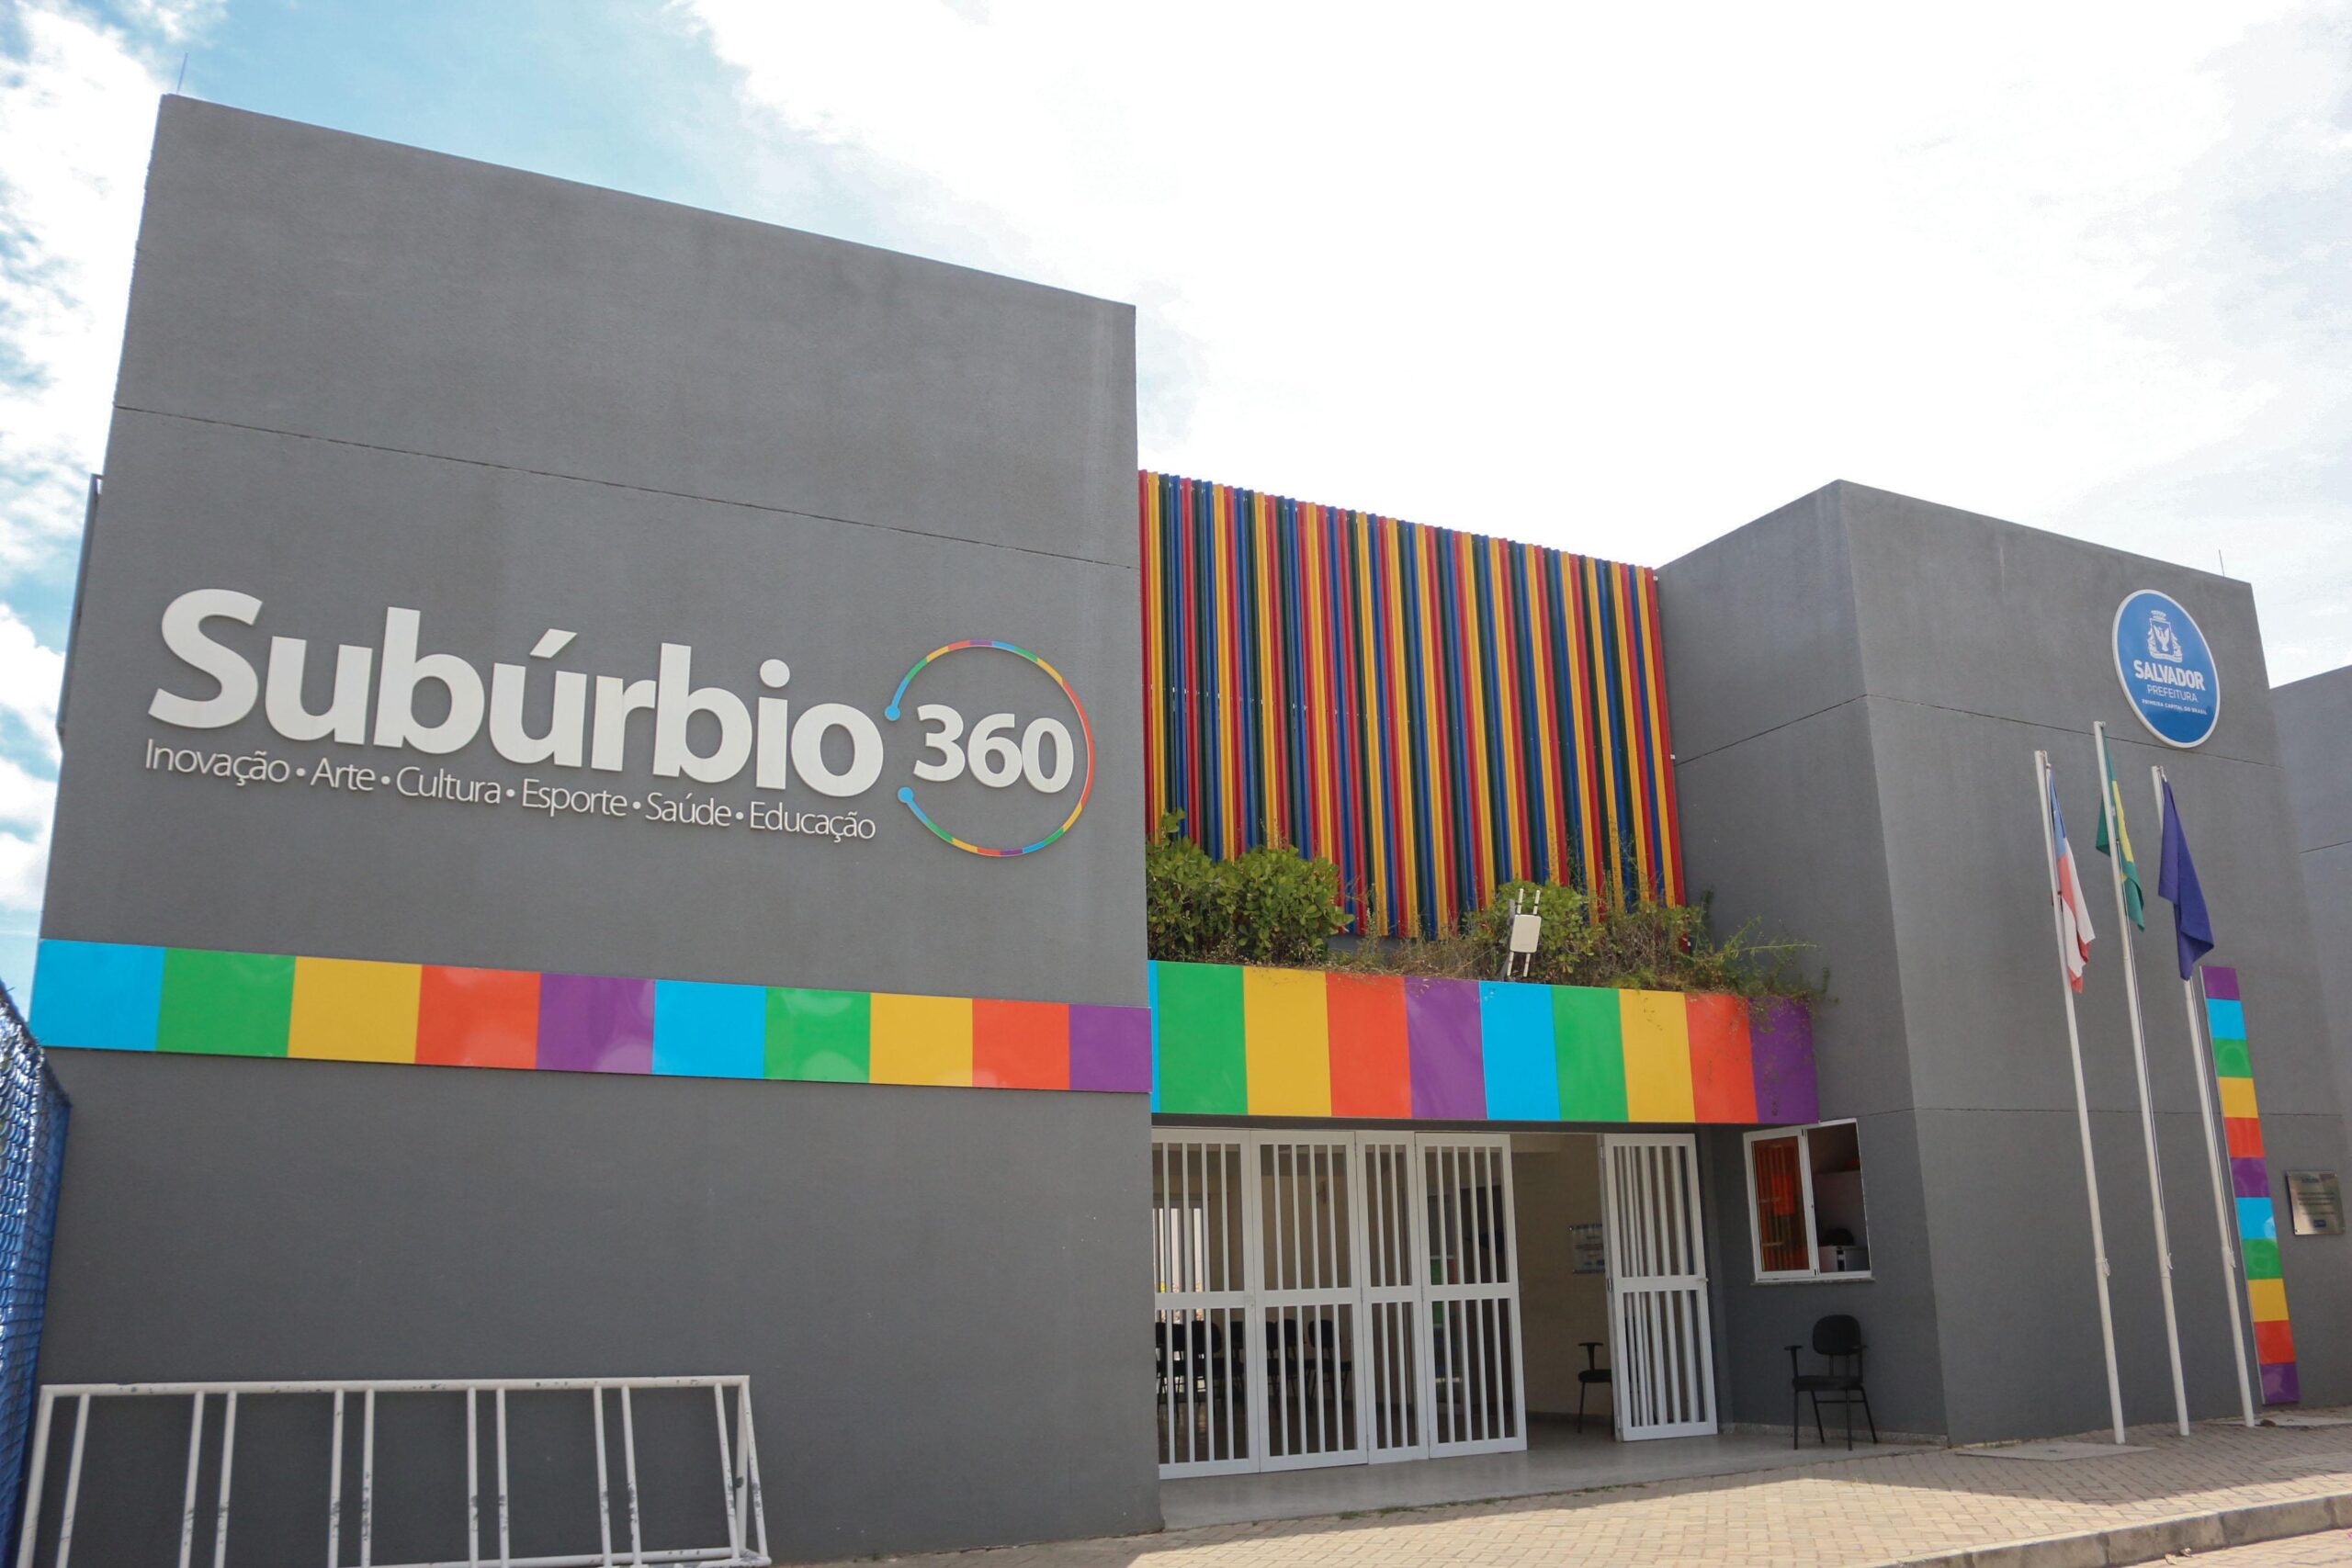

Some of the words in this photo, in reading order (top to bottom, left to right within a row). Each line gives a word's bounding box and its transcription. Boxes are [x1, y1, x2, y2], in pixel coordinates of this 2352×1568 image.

[147, 588, 885, 798] Subúrbio
[912, 703, 1075, 795] 360
[2133, 660, 2206, 691] SALVADOR
[2146, 683, 2199, 702] PREFEITURA
[144, 738, 291, 787] Inovação
[310, 757, 377, 792] Arte
[395, 765, 502, 806] Cultura
[521, 778, 628, 818] Esporte
[644, 791, 733, 828] Saúde
[749, 800, 877, 844] Educação
